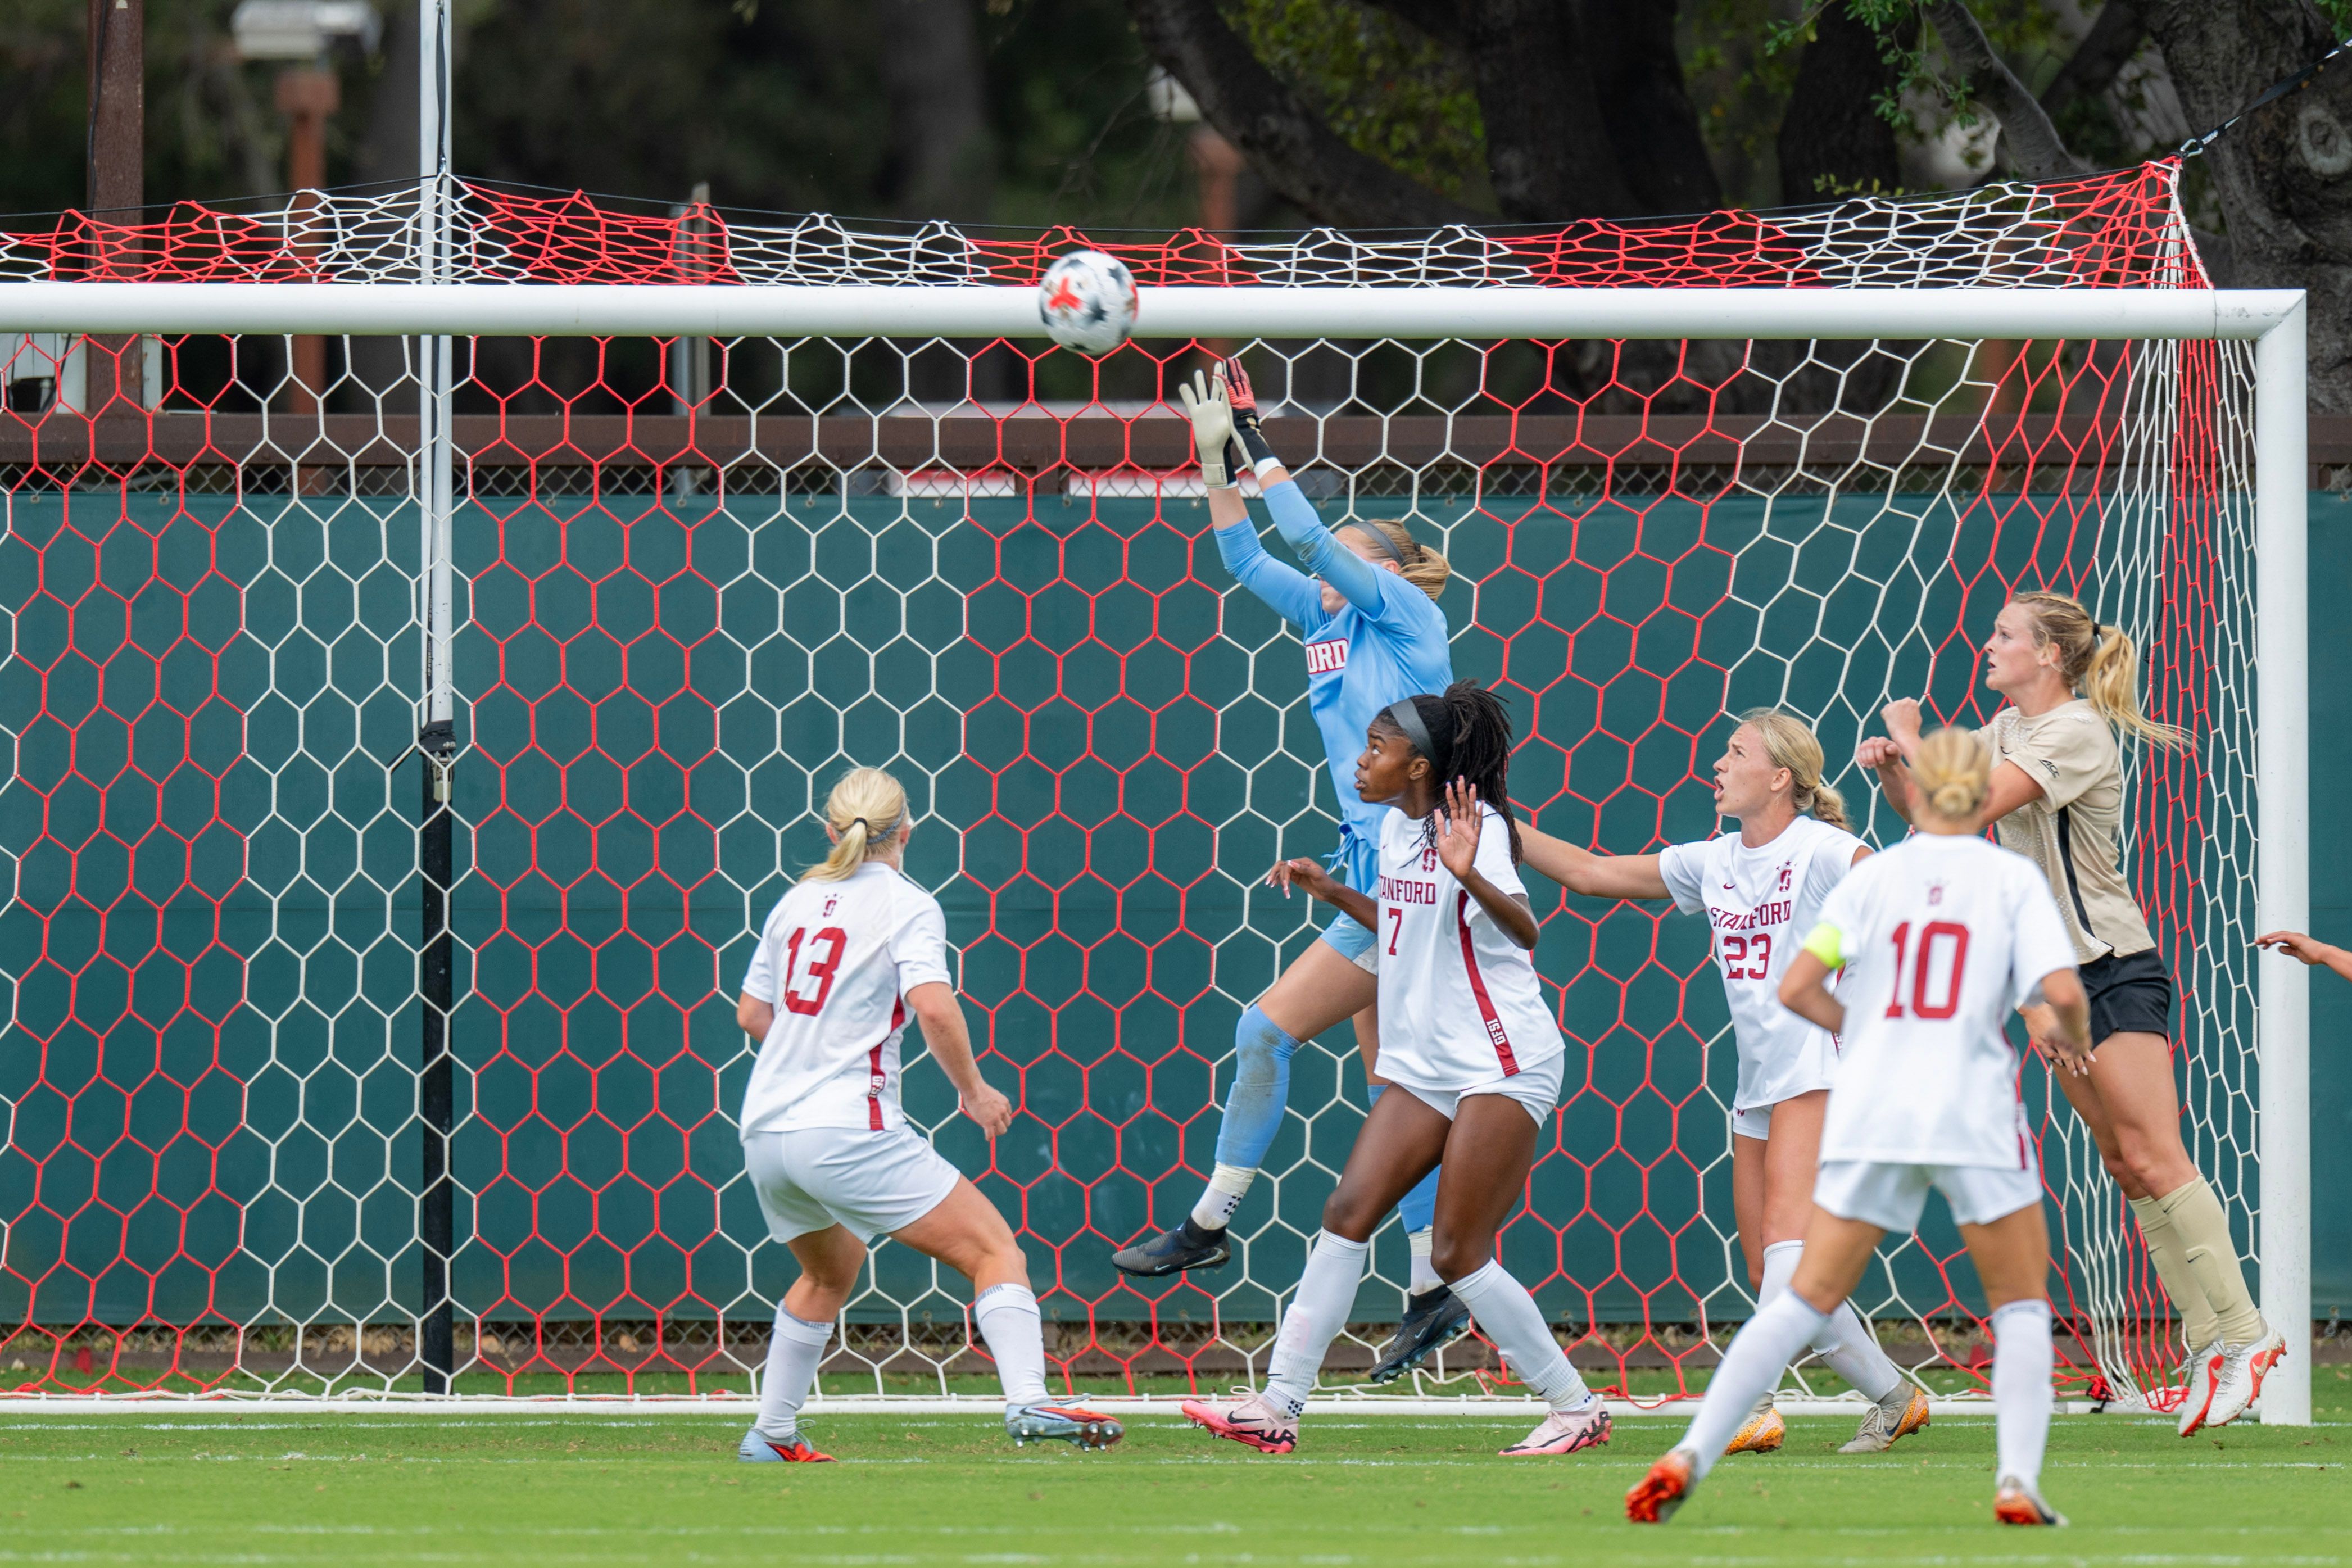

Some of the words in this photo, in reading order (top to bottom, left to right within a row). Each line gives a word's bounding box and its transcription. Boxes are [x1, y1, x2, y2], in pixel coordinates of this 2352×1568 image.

[1379, 874, 1436, 905] TANFORD
[1388, 907, 1403, 957] 7
[1710, 899, 1792, 931] STANFORD
[780, 927, 849, 1017] 13
[1723, 933, 1772, 980] 23
[1886, 921, 1970, 1019] 10
[1485, 1018, 1507, 1046] GFSI
